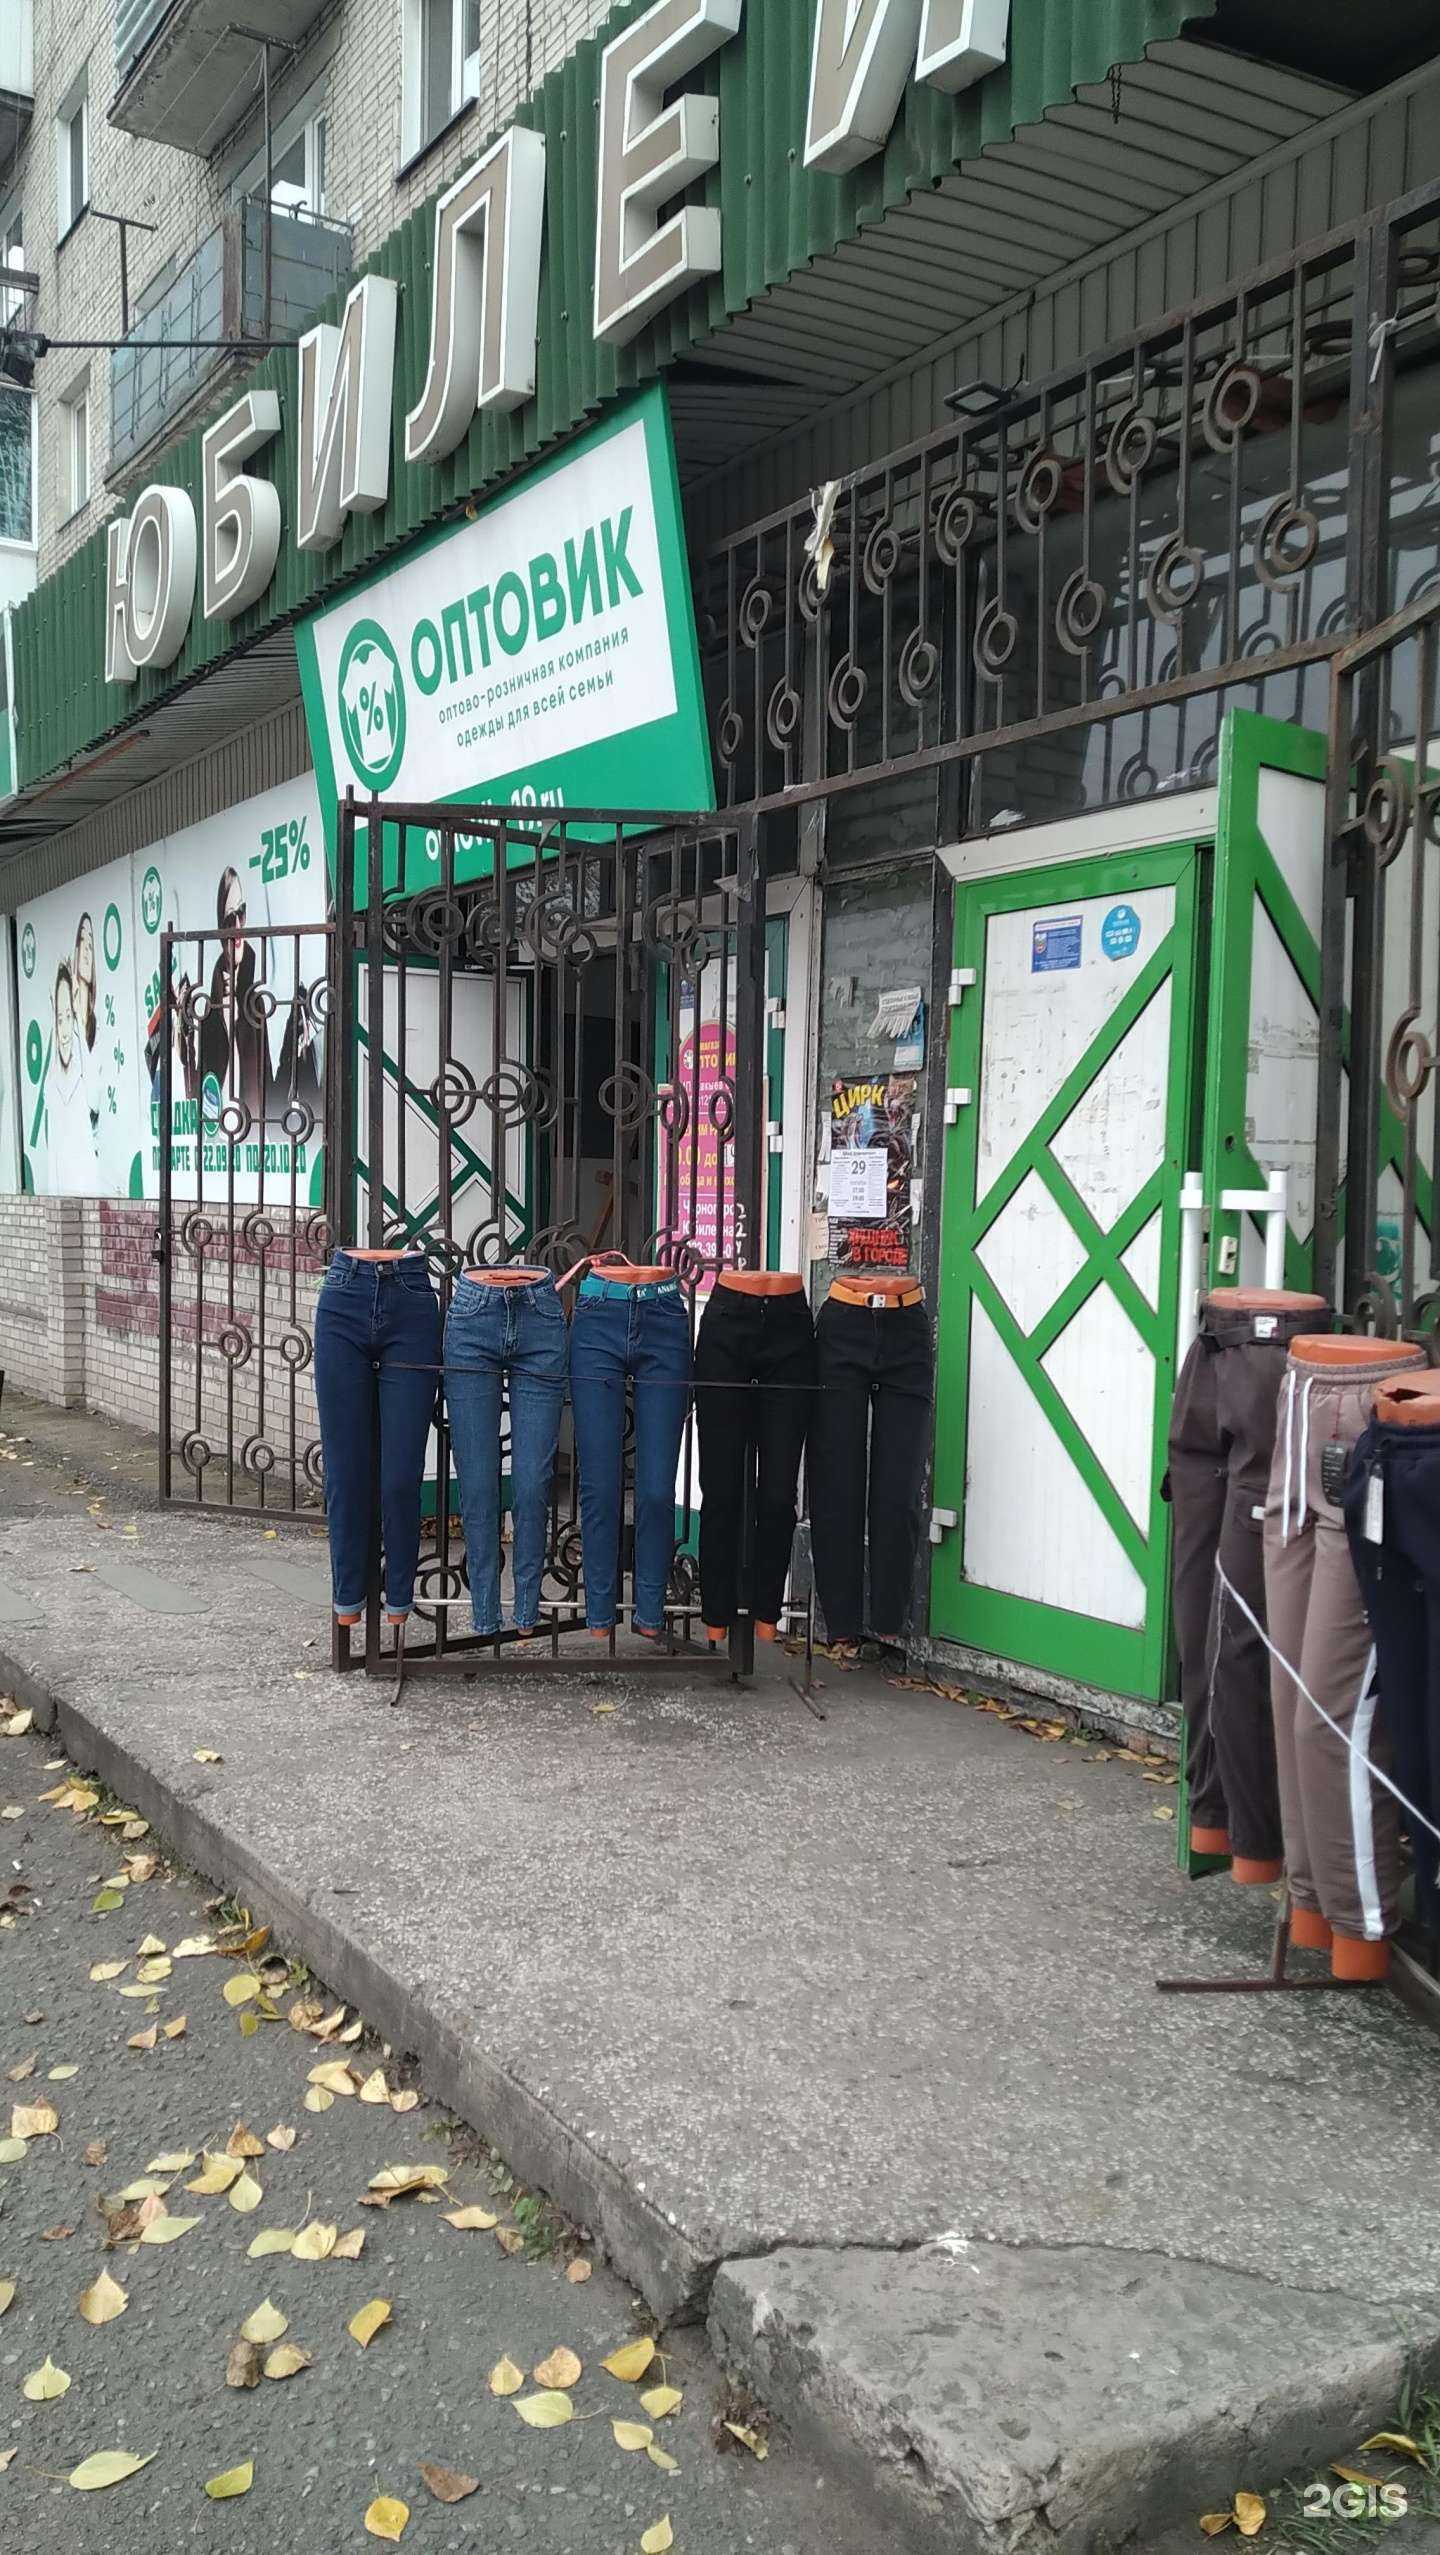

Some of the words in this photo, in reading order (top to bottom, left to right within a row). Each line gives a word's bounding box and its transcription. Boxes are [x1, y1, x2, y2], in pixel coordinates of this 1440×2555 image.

[410, 504, 645, 697] ОПТОВИК
[438, 659, 556, 725] оптово-розничная
[559, 626, 630, 673] компания
[456, 718, 505, 748] одежды
[506, 708, 531, 732] для
[533, 687, 567, 719] всей
[569, 671, 614, 702] семьи
[248, 815, 311, 884] -25%
[151, 1098, 199, 1137] СДКА
[833, 1084, 885, 1119] ЦИРК
[203, 1144, 241, 1172] 22.090
[851, 1160, 867, 1175] 29
